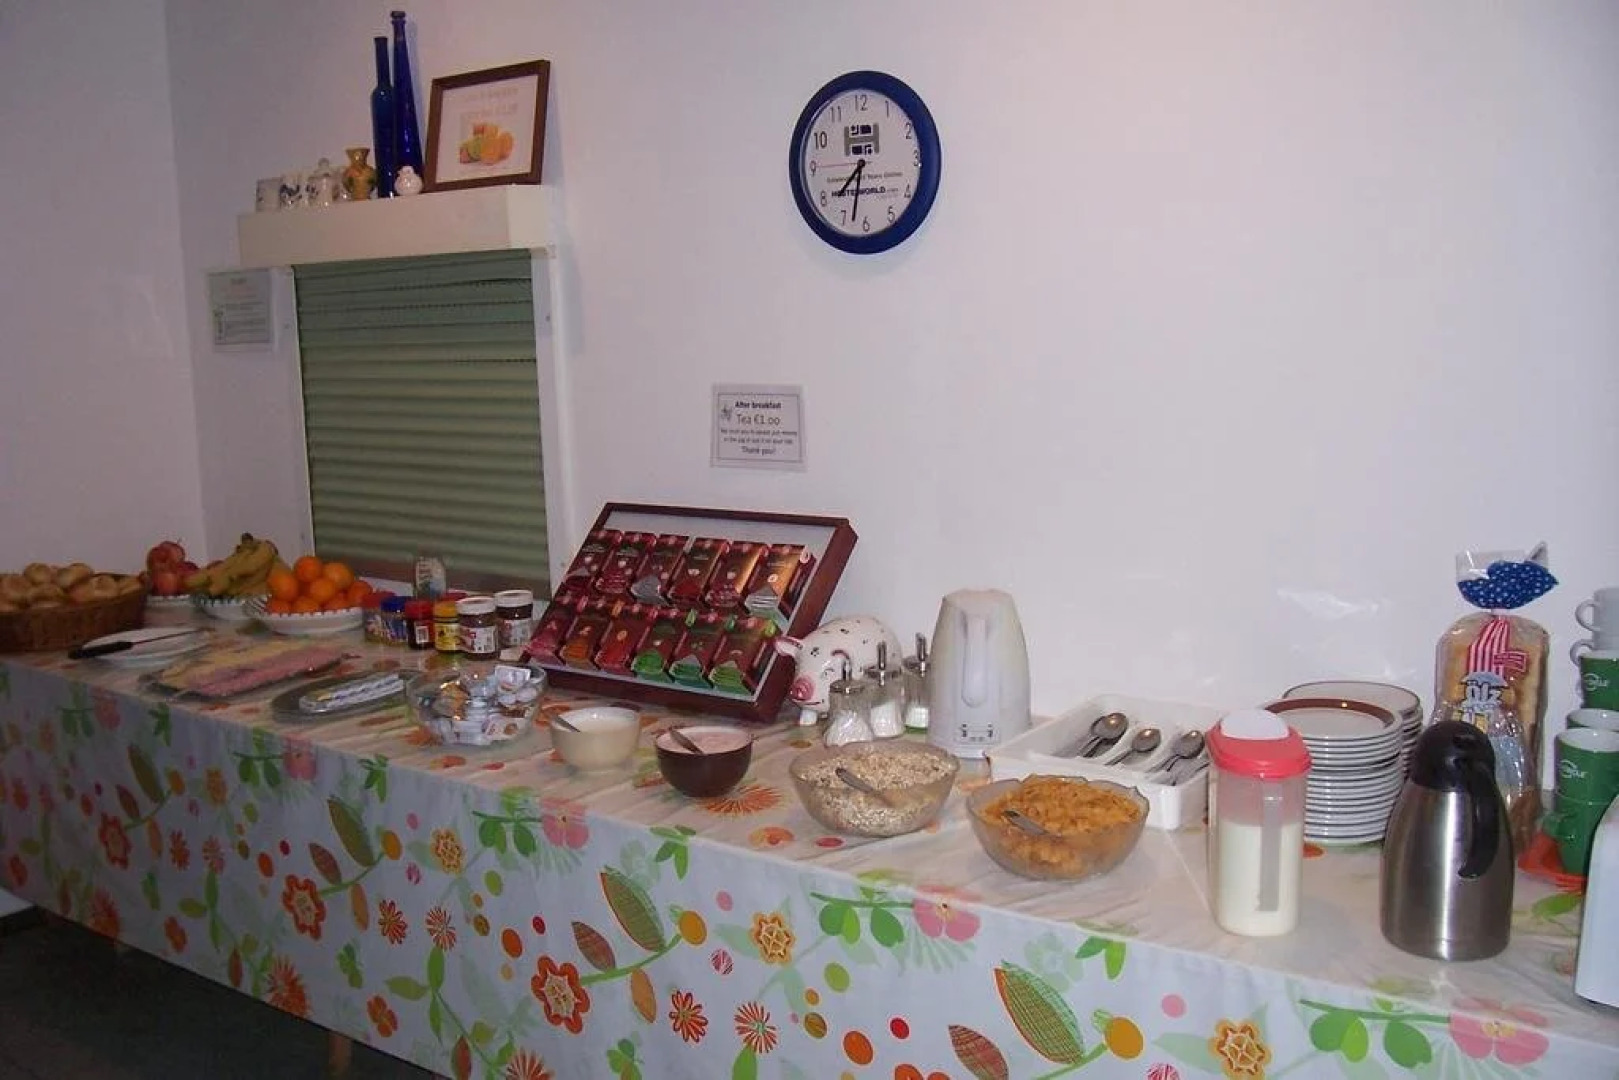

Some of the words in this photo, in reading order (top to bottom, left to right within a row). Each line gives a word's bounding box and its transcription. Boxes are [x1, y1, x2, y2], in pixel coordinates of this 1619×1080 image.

[855, 94, 868, 112] 12
[884, 100, 890, 118] 1
[830, 105, 842, 123] 11
[905, 121, 912, 140] 2
[813, 130, 828, 149] 10
[913, 149, 920, 167] 3
[809, 160, 817, 177] 9
[820, 190, 828, 208] 8
[903, 183, 912, 199] 4
[840, 209, 847, 226] 7
[888, 206, 896, 223] 5
[862, 216, 871, 232] 6
[735, 401, 750, 409] After
[752, 401, 782, 409] breakfast
[737, 413, 752, 425] Tea
